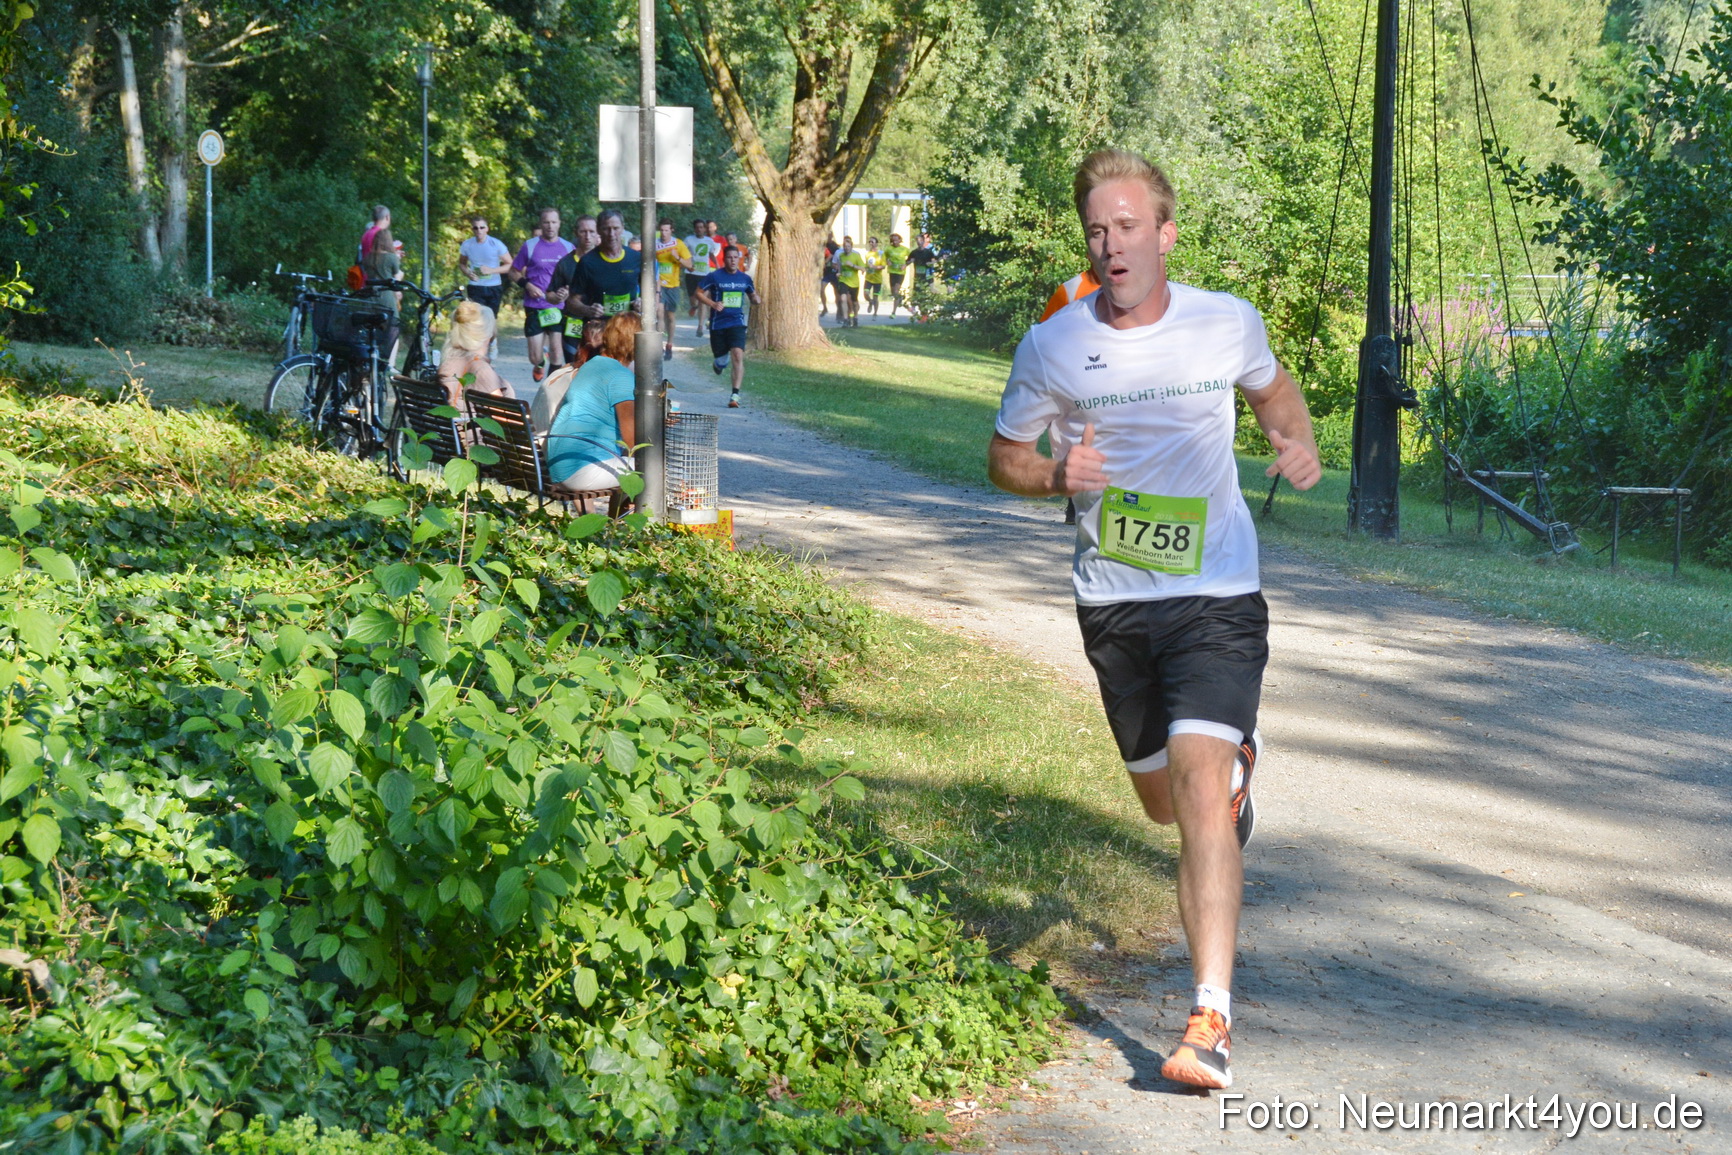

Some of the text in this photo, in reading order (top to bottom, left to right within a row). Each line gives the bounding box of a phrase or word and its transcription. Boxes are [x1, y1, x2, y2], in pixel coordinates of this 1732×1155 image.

[609, 302, 625, 311] 291
[1084, 363, 1107, 371] erima
[1074, 378, 1228, 411] RUPPRECHT HOLZBAU
[1114, 515, 1191, 552] 1758
[1116, 541, 1184, 561] Weißenborn Marc
